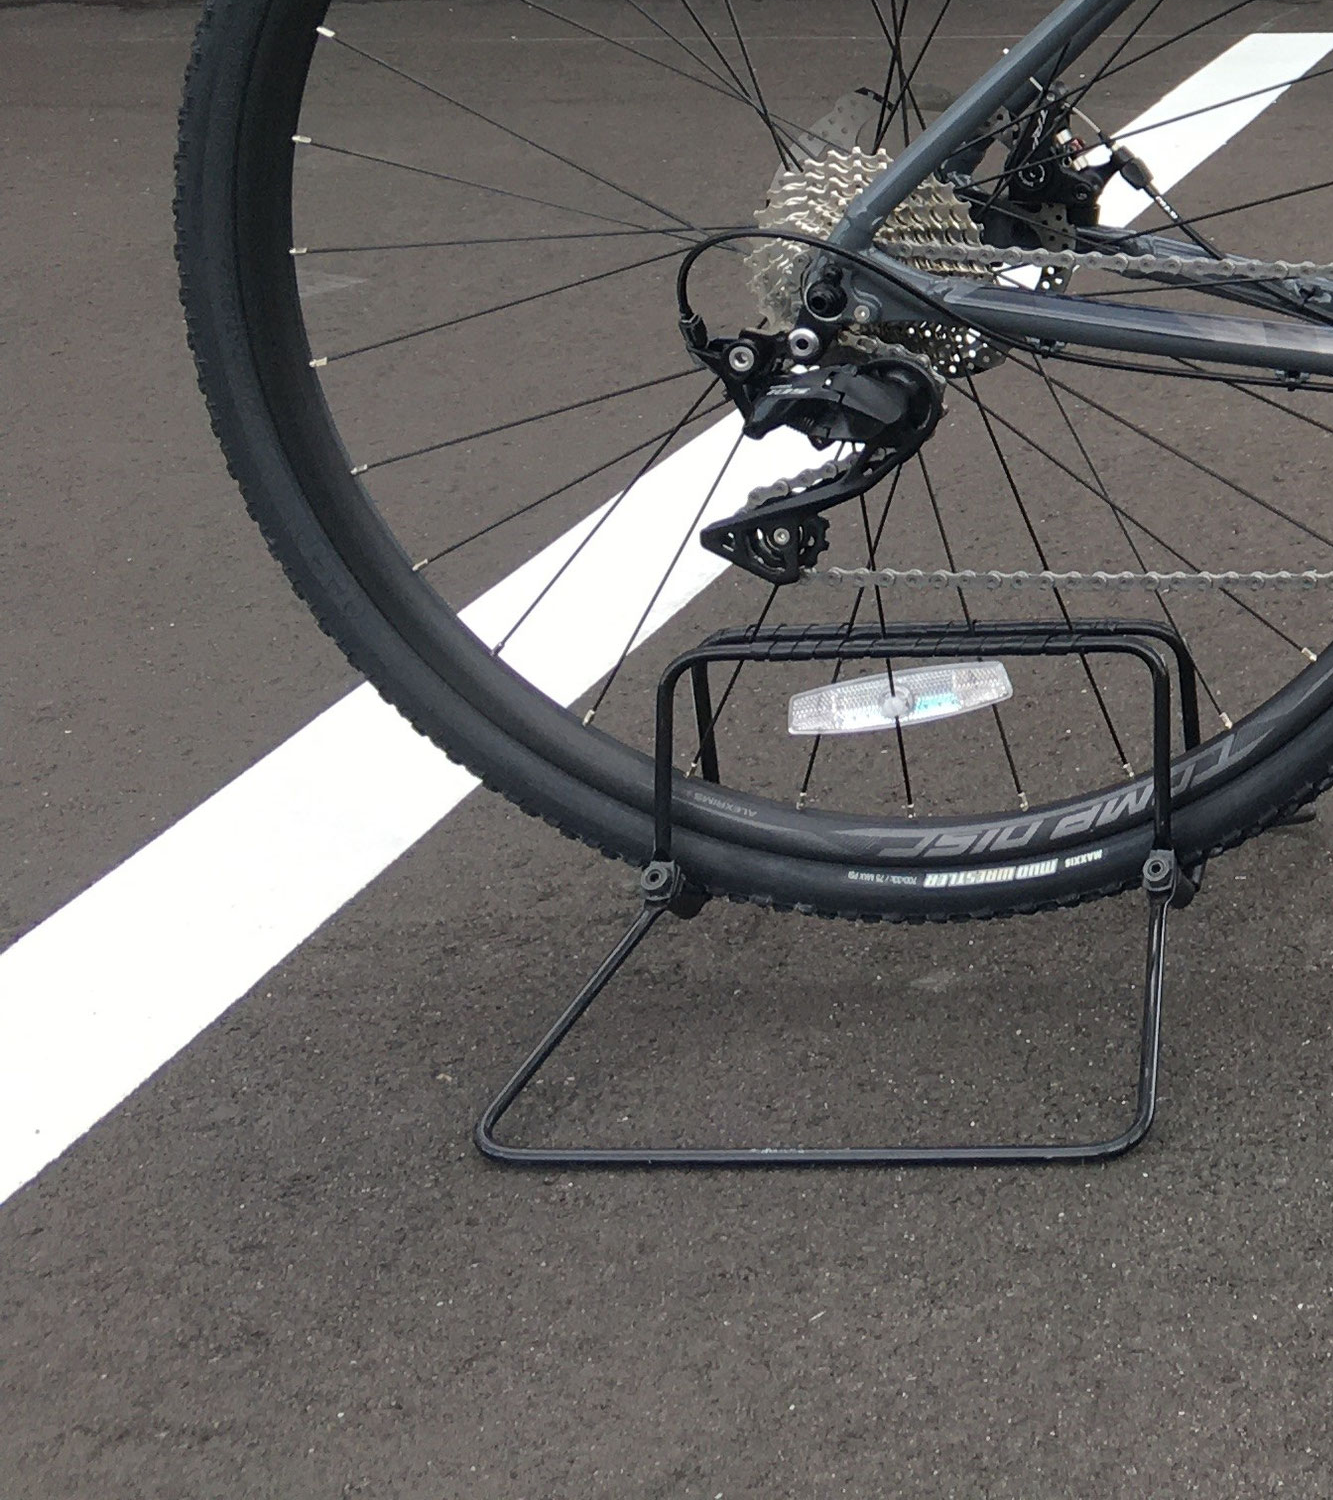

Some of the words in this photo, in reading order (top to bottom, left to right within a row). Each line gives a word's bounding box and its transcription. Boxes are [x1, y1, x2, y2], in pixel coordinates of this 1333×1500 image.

[1016, 857, 1060, 880] MUD
[1065, 849, 1104, 869] MAXXIS
[923, 866, 1017, 889] WRESTLER
